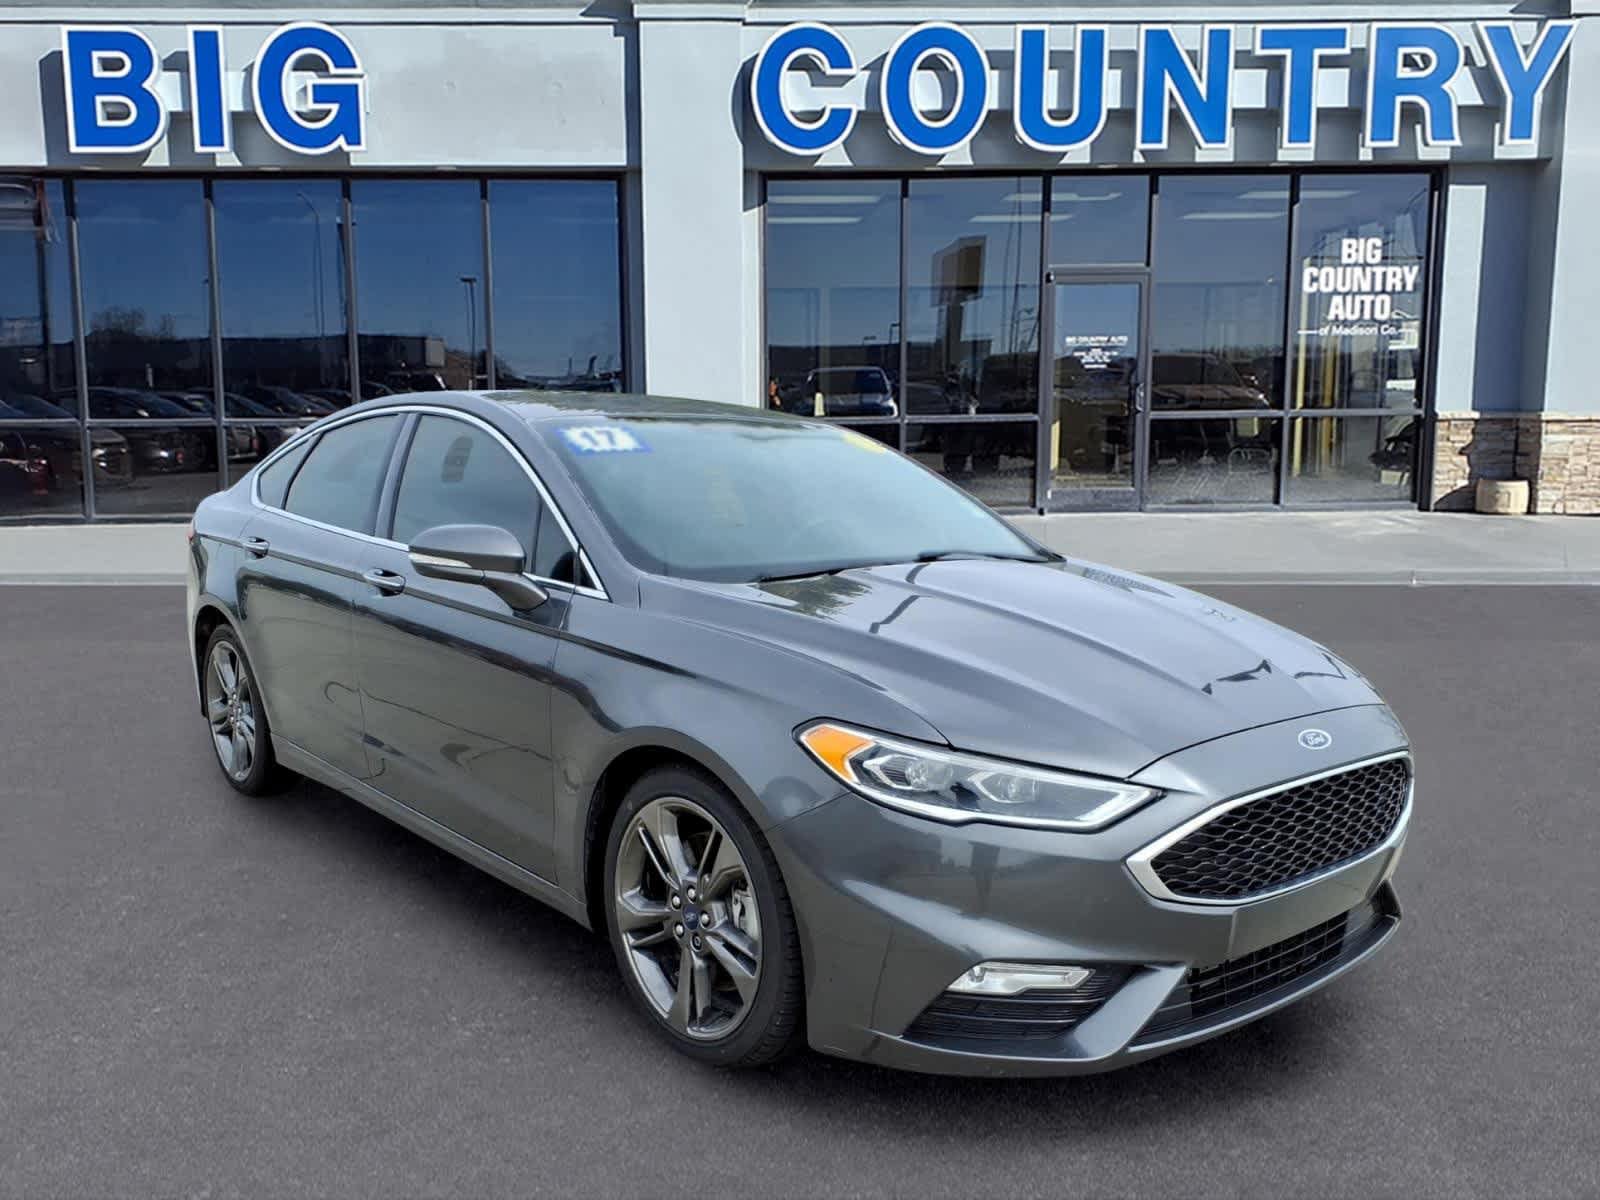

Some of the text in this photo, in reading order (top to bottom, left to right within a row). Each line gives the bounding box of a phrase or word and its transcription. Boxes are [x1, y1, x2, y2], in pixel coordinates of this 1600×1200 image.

[61, 20, 1575, 155] BIG COUNTRY
[1341, 237, 1382, 265] BIG
[1303, 266, 1419, 294] COUNTRY
[1328, 294, 1392, 321] AUTO
[1319, 324, 1330, 336] of
[1331, 324, 1378, 336] Madison
